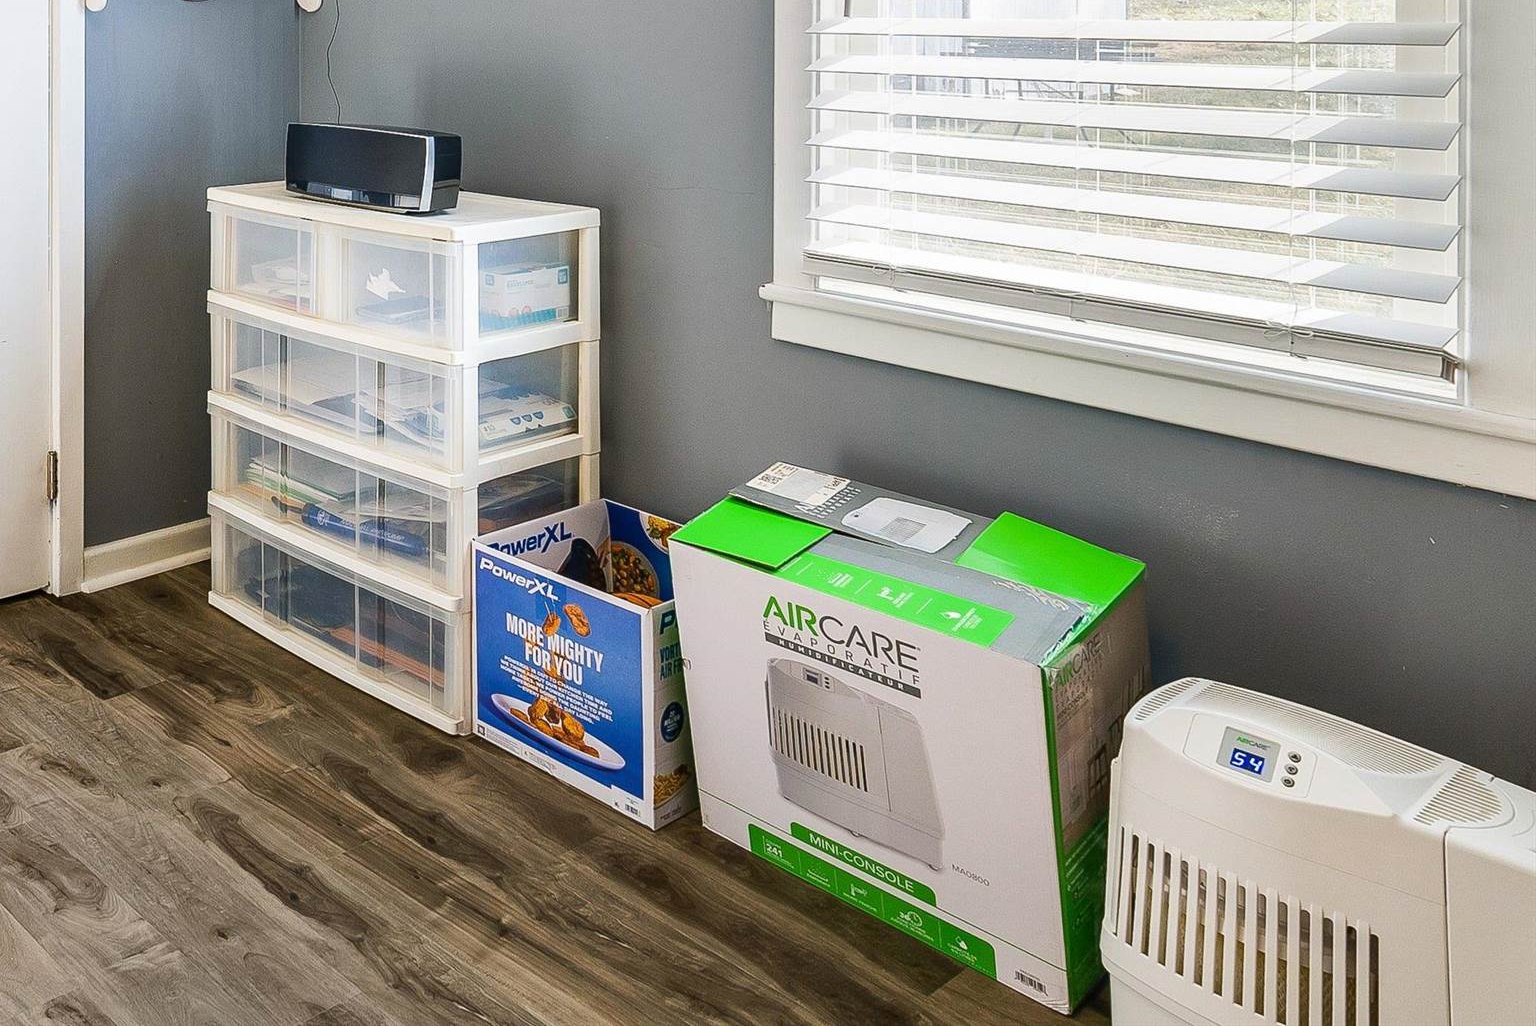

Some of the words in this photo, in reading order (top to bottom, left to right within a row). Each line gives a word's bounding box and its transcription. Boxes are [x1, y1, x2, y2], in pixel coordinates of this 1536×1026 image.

[479, 557, 559, 602] PowerXL
[506, 612, 543, 647] MORE
[547, 630, 603, 673] MIGHTY
[763, 596, 920, 673] AIRCARE
[525, 641, 550, 671] FOR
[554, 654, 582, 686] YOU
[778, 638, 905, 691] HUMIDIFICATEUR
[1231, 751, 1263, 772] 54
[766, 843, 783, 858] 241
[809, 832, 913, 893] MINI-CONSOLE
